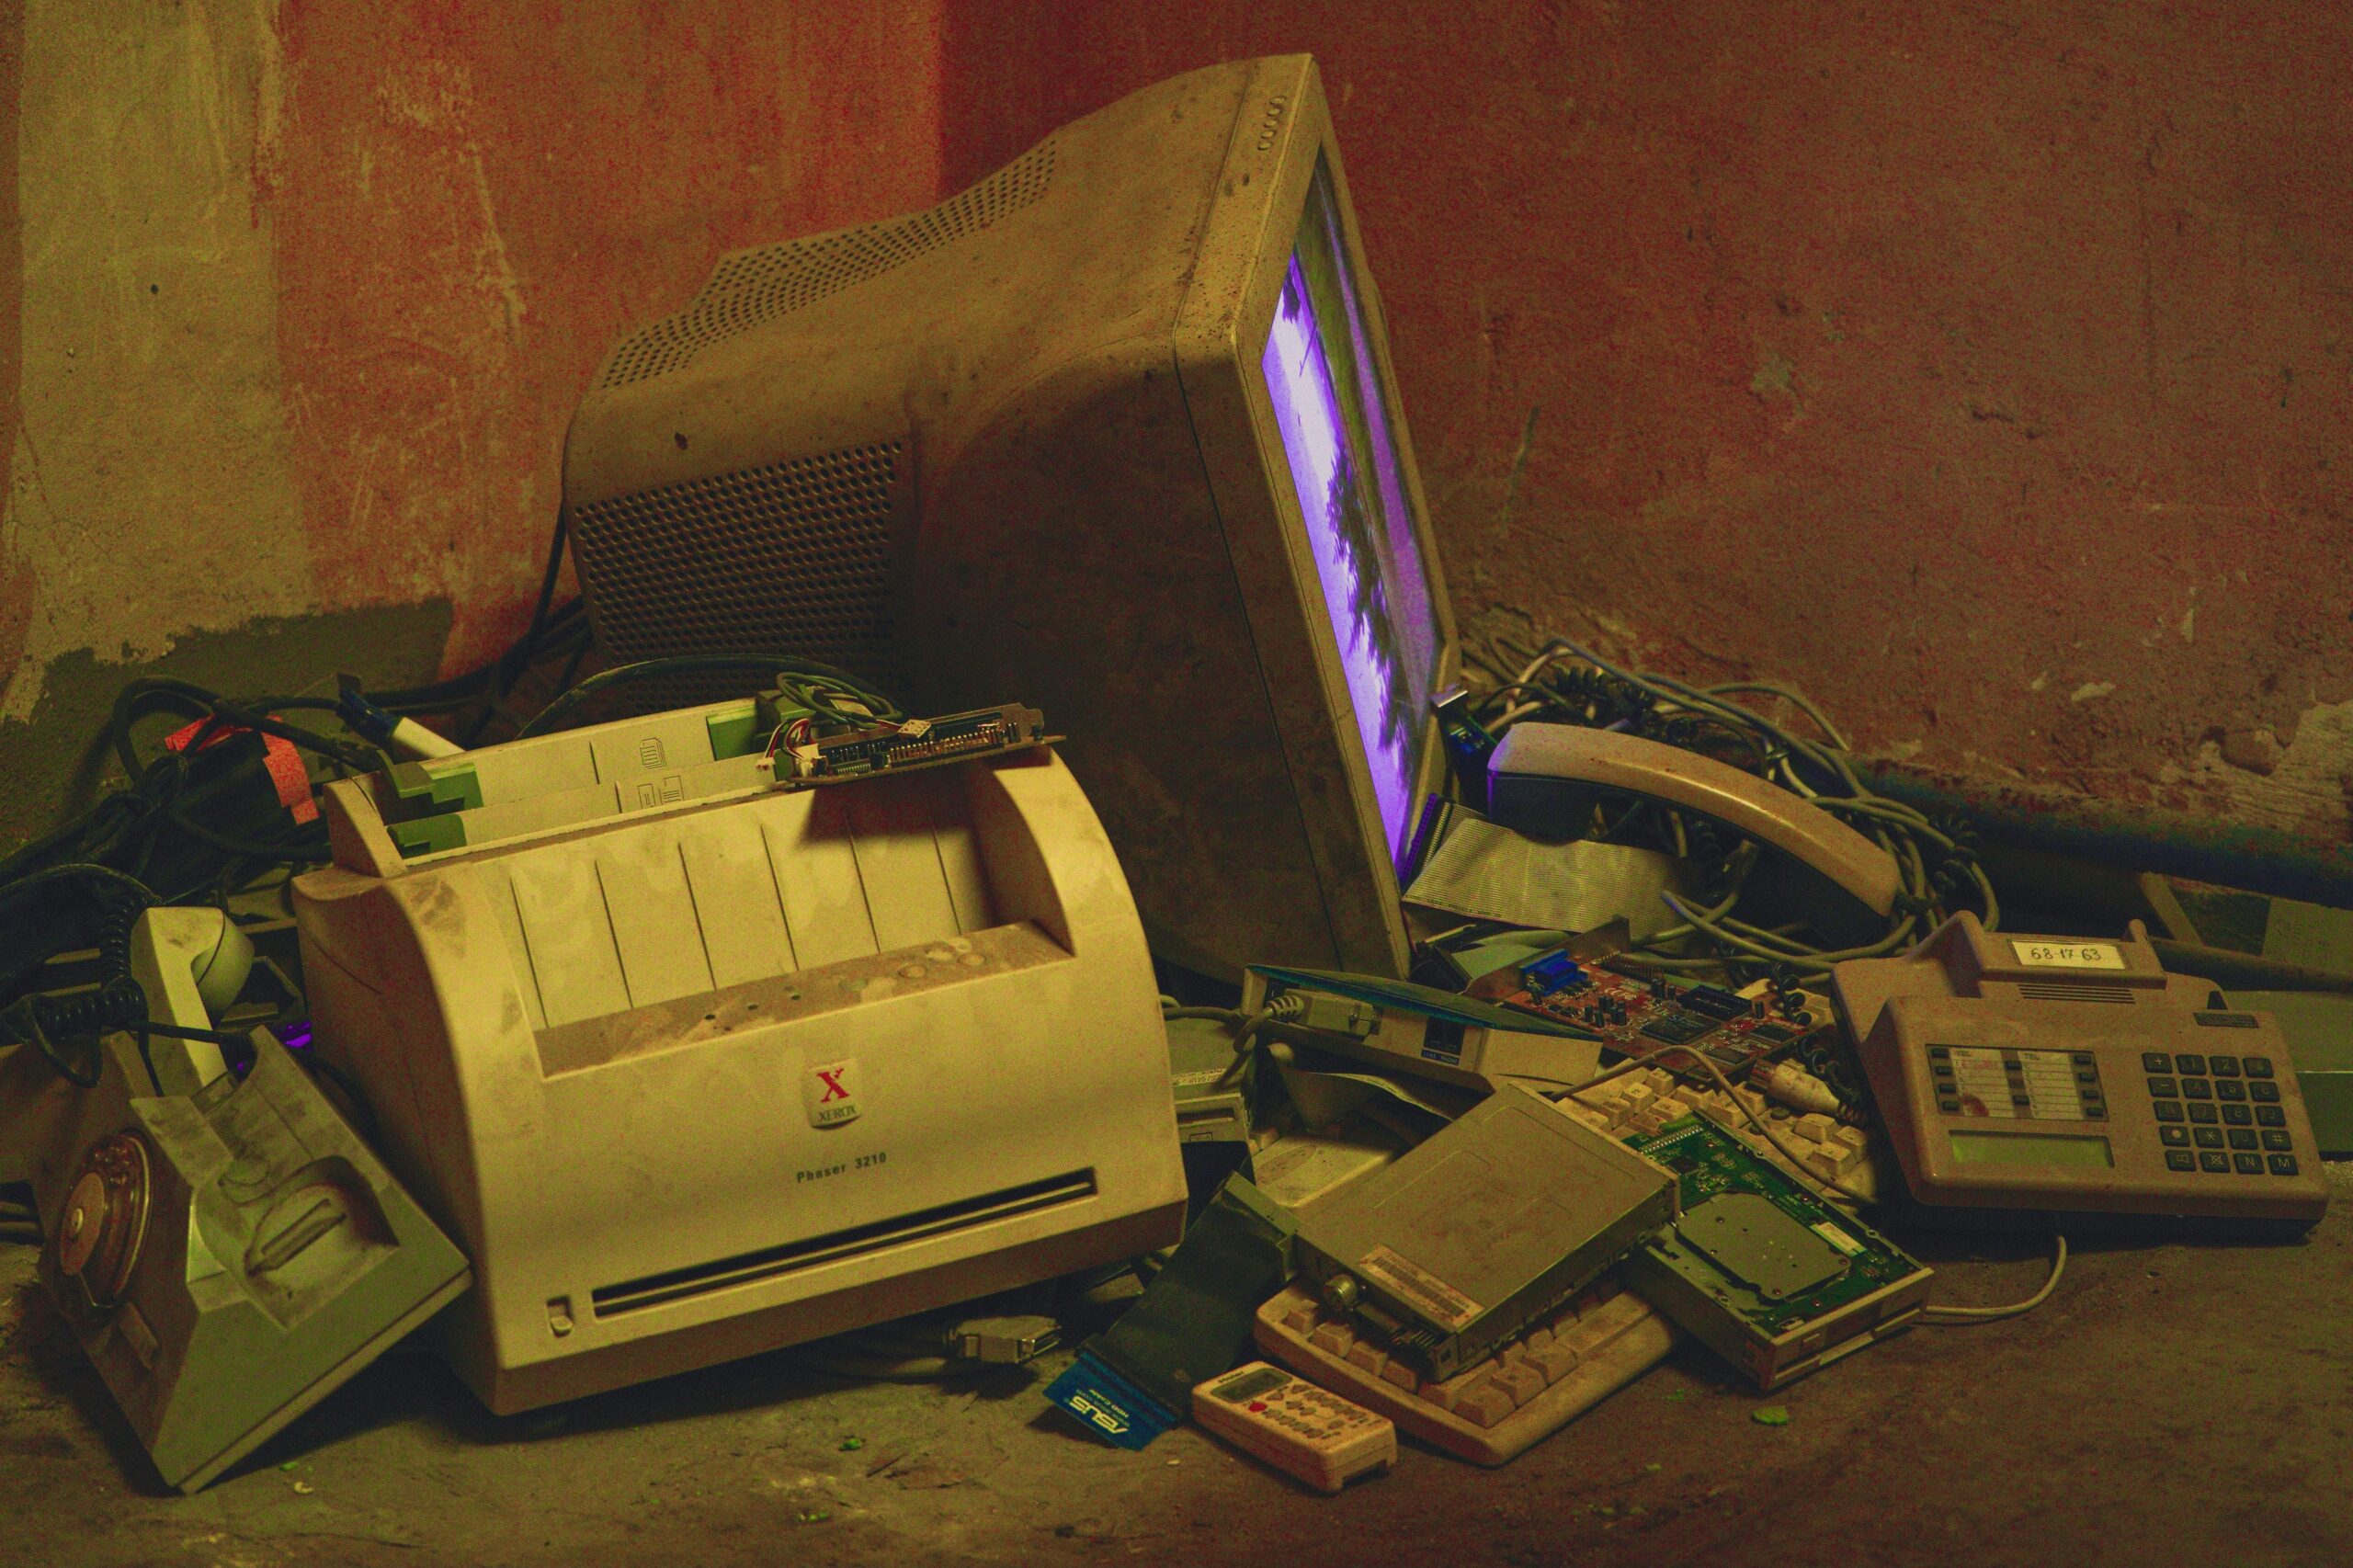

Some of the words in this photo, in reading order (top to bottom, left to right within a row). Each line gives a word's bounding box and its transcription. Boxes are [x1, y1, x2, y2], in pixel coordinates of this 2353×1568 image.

[2222, 1059, 2231, 1070] 2
[816, 1067, 850, 1103] X
[819, 1105, 857, 1121] XEROX
[797, 1164, 847, 1183] Phaser
[855, 1152, 887, 1169] 3210
[2245, 1157, 2256, 1167] N
[2278, 1157, 2290, 1168] M
[1069, 1395, 1129, 1434] ASUS
